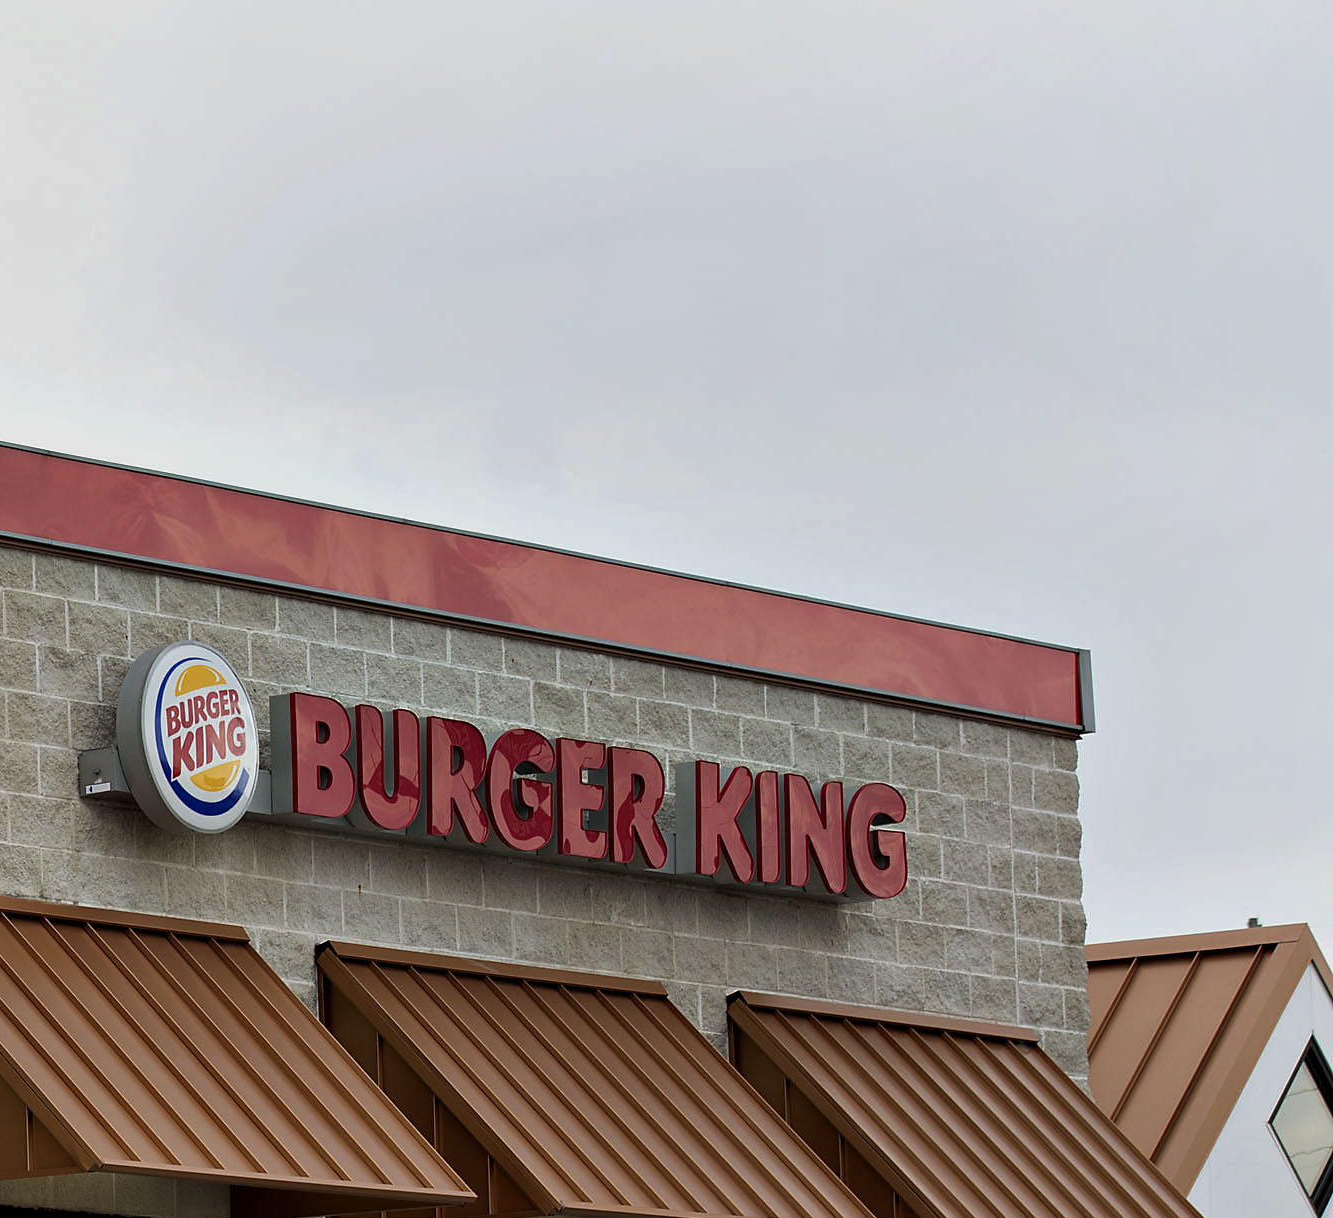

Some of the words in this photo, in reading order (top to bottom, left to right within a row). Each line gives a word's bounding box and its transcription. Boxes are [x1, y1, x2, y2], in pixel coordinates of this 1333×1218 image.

[166, 688, 241, 738] BURGER
[172, 716, 246, 779] KING
[289, 692, 668, 870] BURGER
[695, 759, 909, 899] KING
